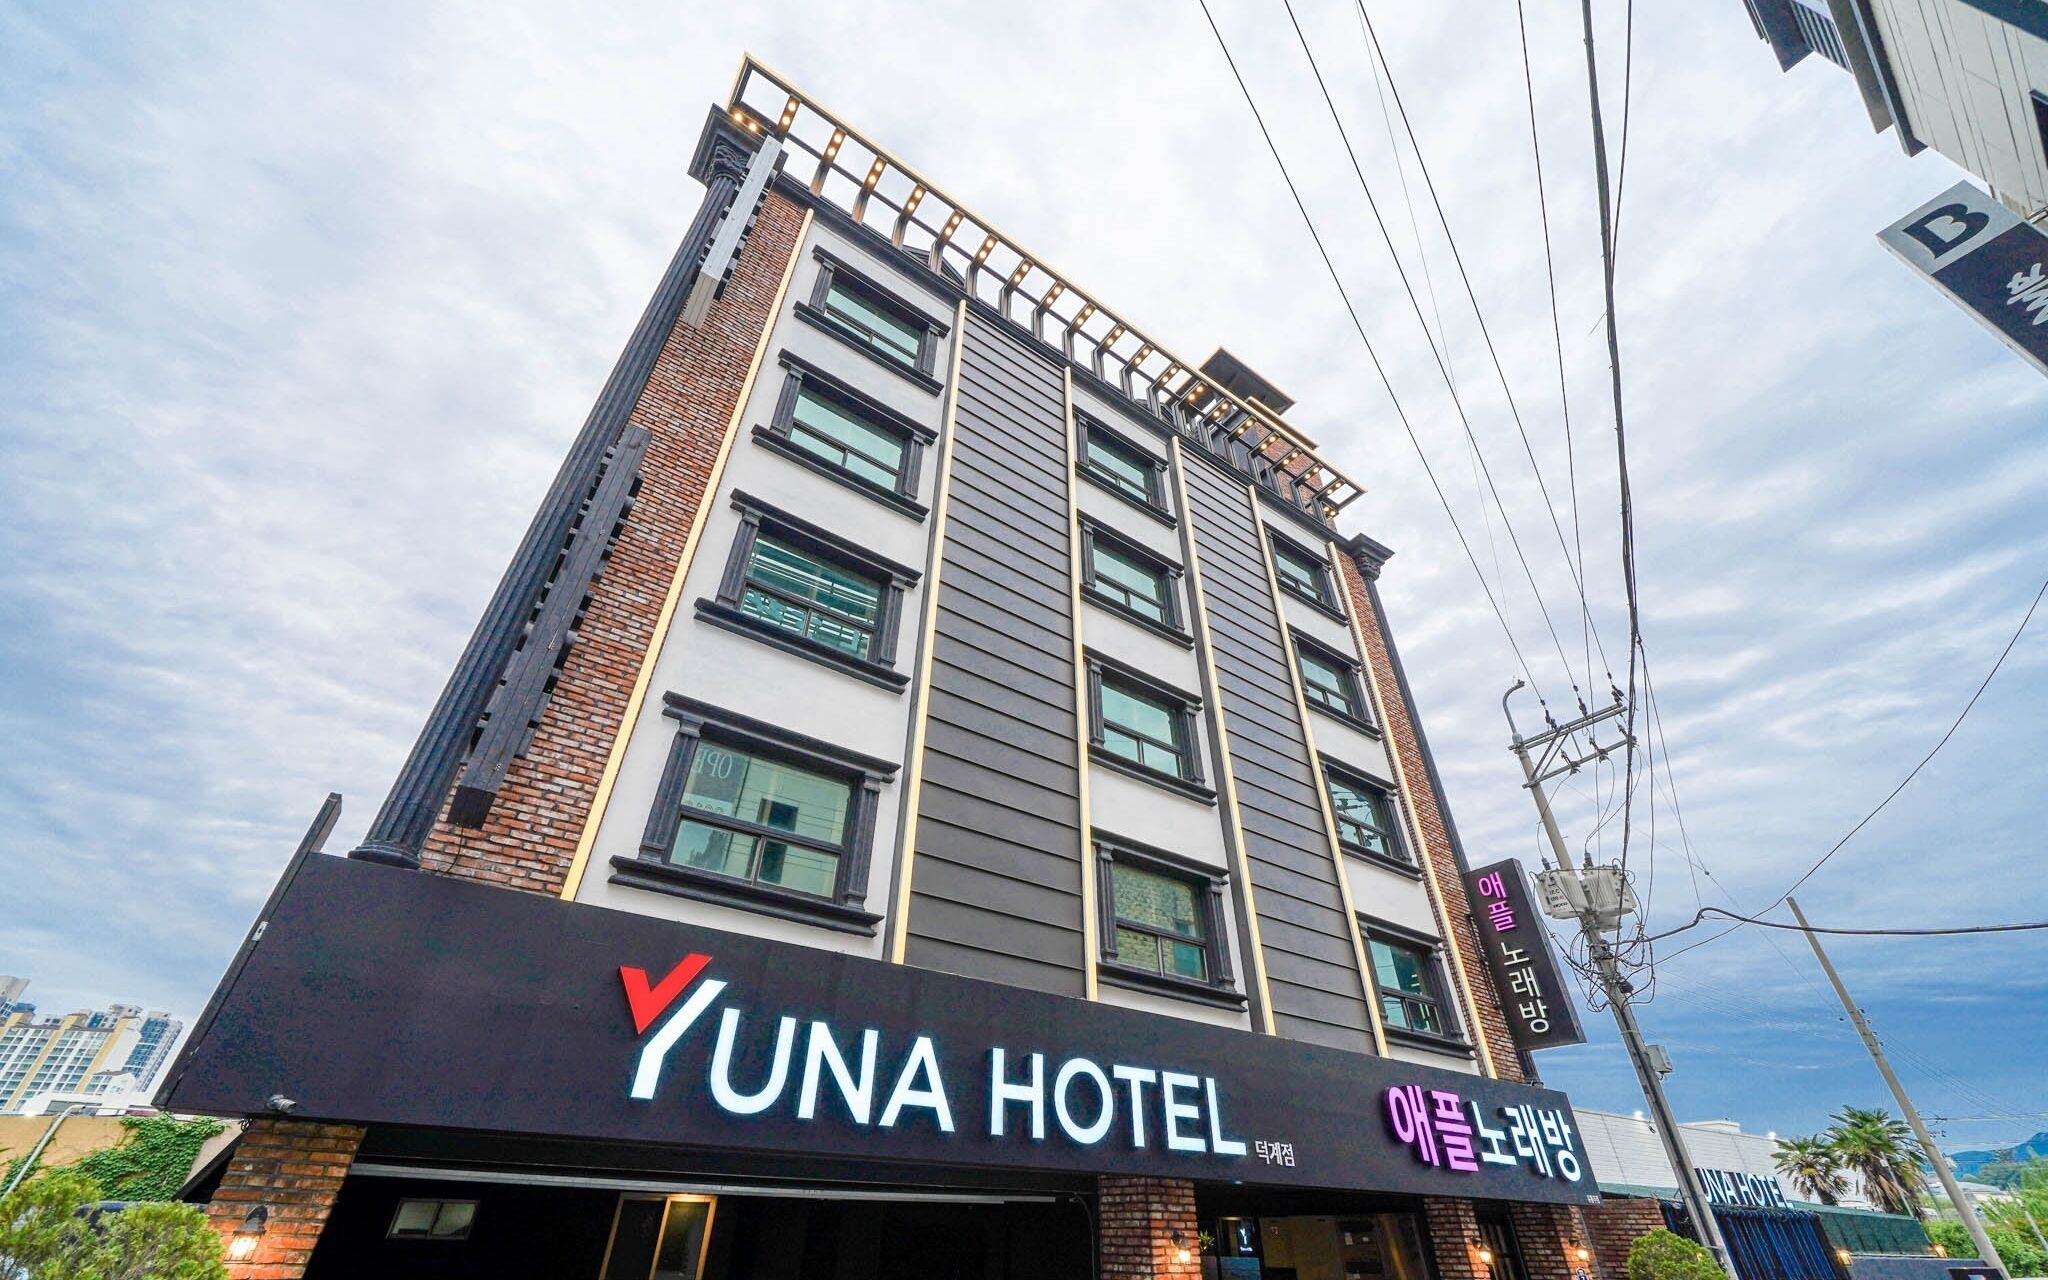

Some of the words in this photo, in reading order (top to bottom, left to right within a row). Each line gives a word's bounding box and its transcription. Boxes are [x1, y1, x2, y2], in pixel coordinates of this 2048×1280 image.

[1901, 203, 1990, 260] B
[619, 953, 955, 1133] YUNA
[990, 1047, 1247, 1157] HOTEL
[1255, 1140, 1296, 1168] 덕계점
[1734, 1172, 1794, 1209] HOTEL
